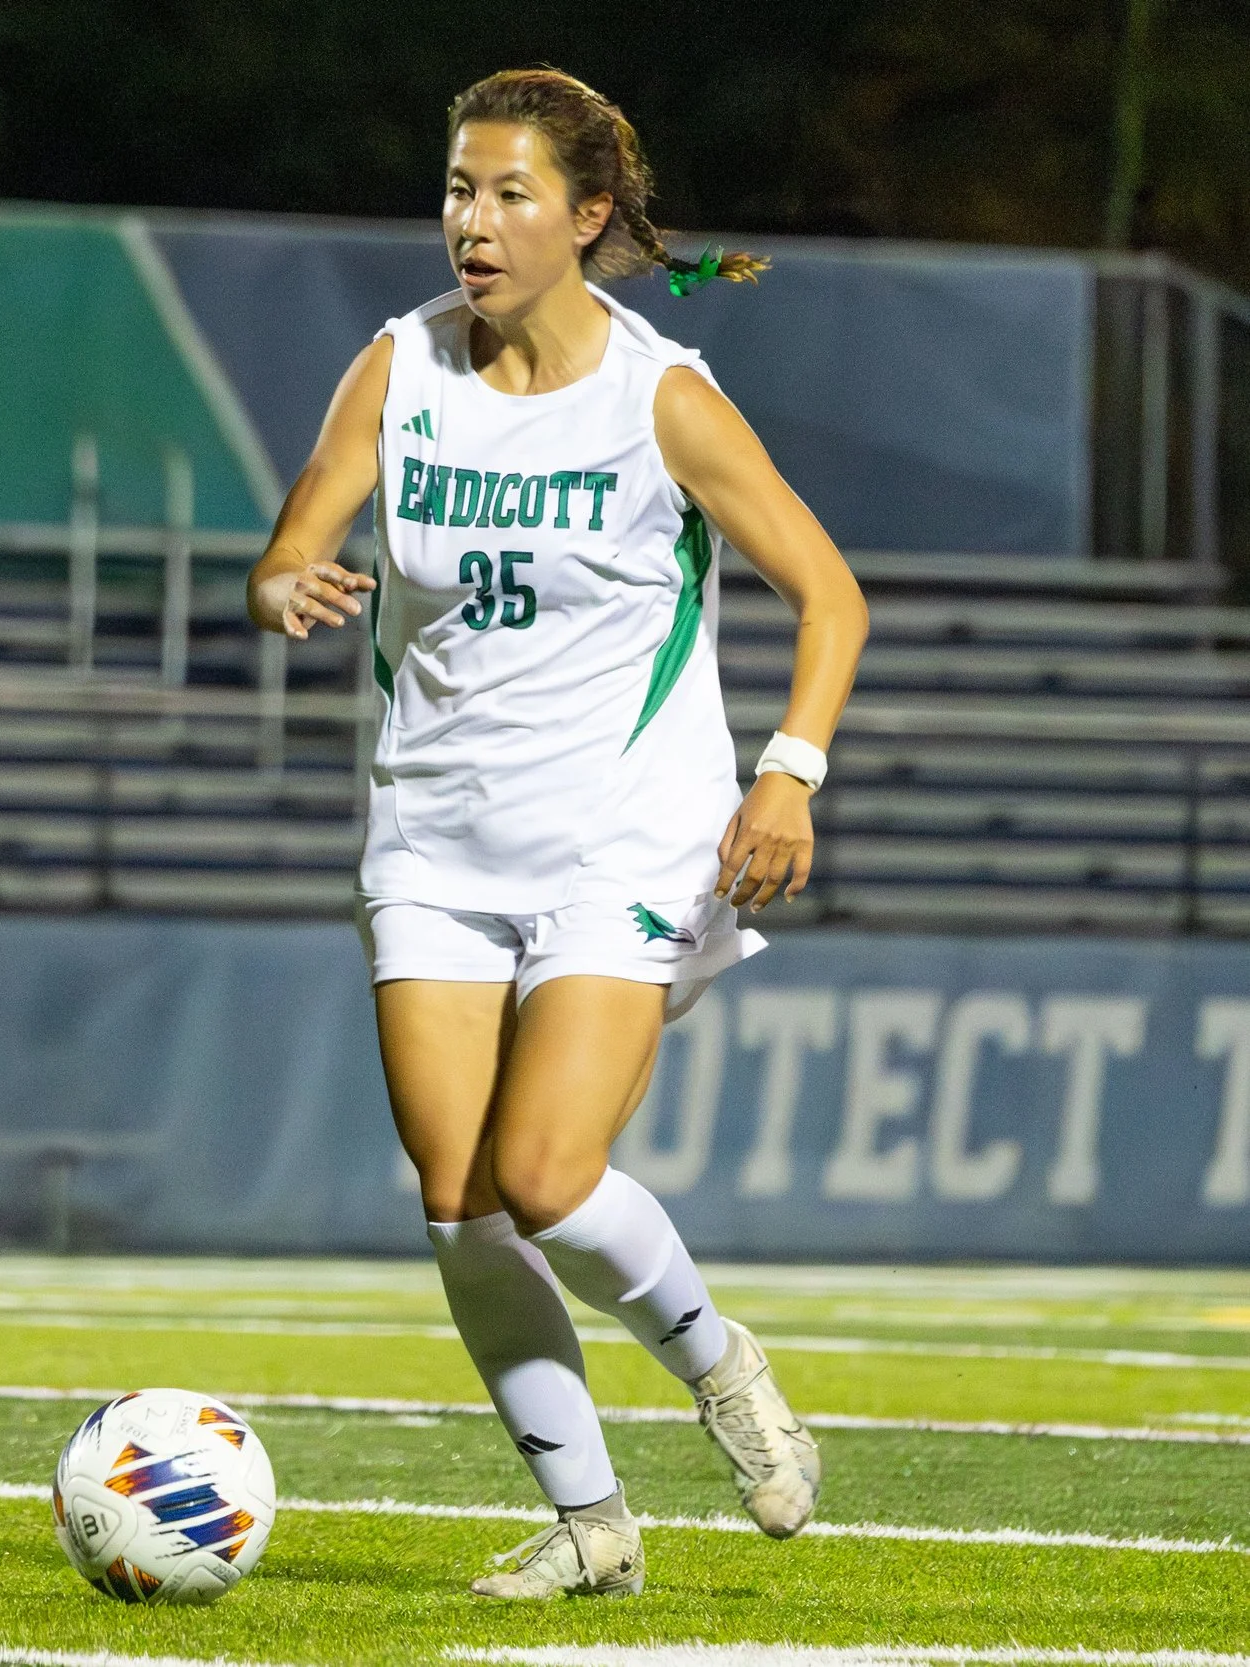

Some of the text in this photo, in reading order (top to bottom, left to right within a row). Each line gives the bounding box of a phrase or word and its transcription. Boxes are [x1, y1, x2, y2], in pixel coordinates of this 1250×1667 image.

[397, 456, 618, 531] ENDICOTT
[459, 550, 537, 630] 35
[395, 989, 1146, 1203] OTECT
